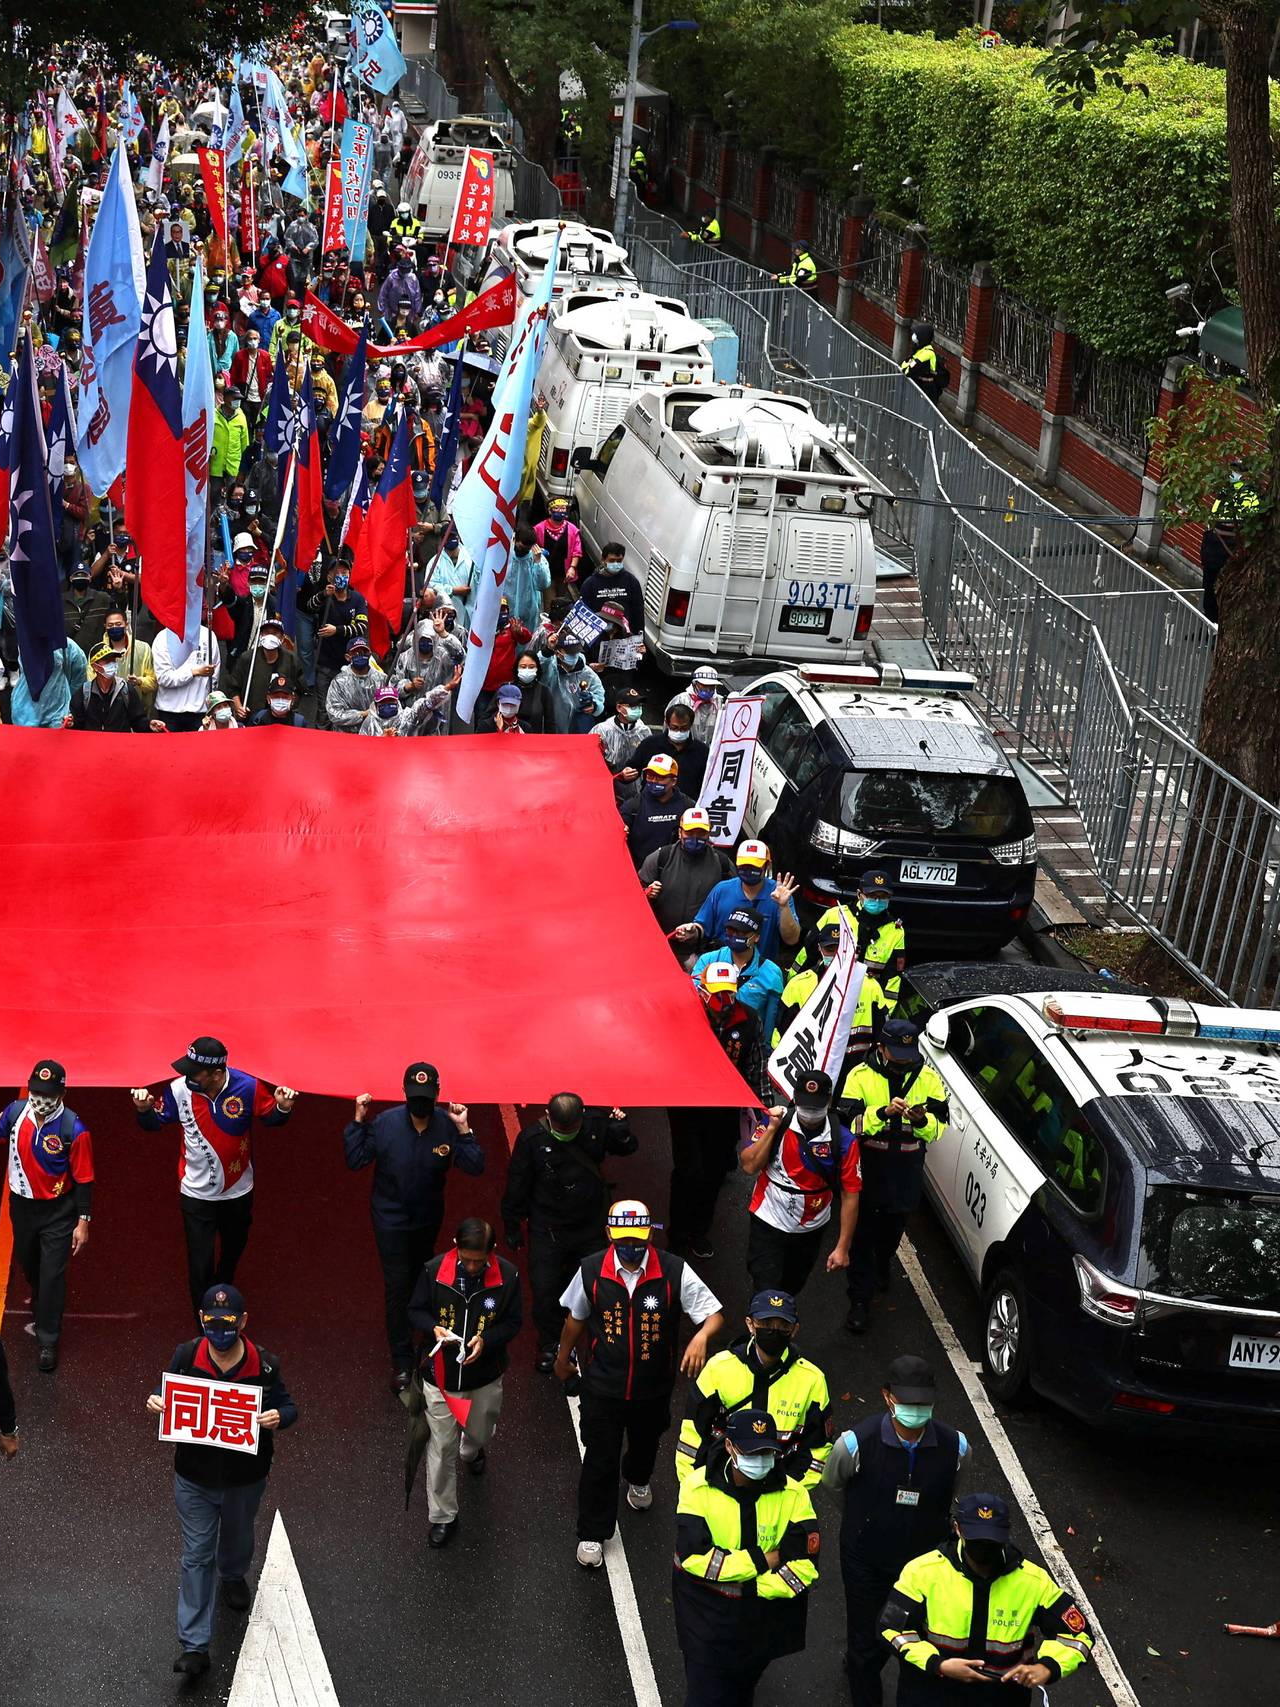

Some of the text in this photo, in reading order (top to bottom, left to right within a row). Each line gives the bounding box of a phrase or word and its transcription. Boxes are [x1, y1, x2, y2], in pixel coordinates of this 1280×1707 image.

[705, 749, 746, 837] 同意
[973, 1138, 998, 1179] 大安分局
[965, 1171, 987, 1229] 023
[1231, 1341, 1280, 1364] ANY·9
[163, 1380, 257, 1446] 同意
[992, 1619, 1020, 1627] POLICE
